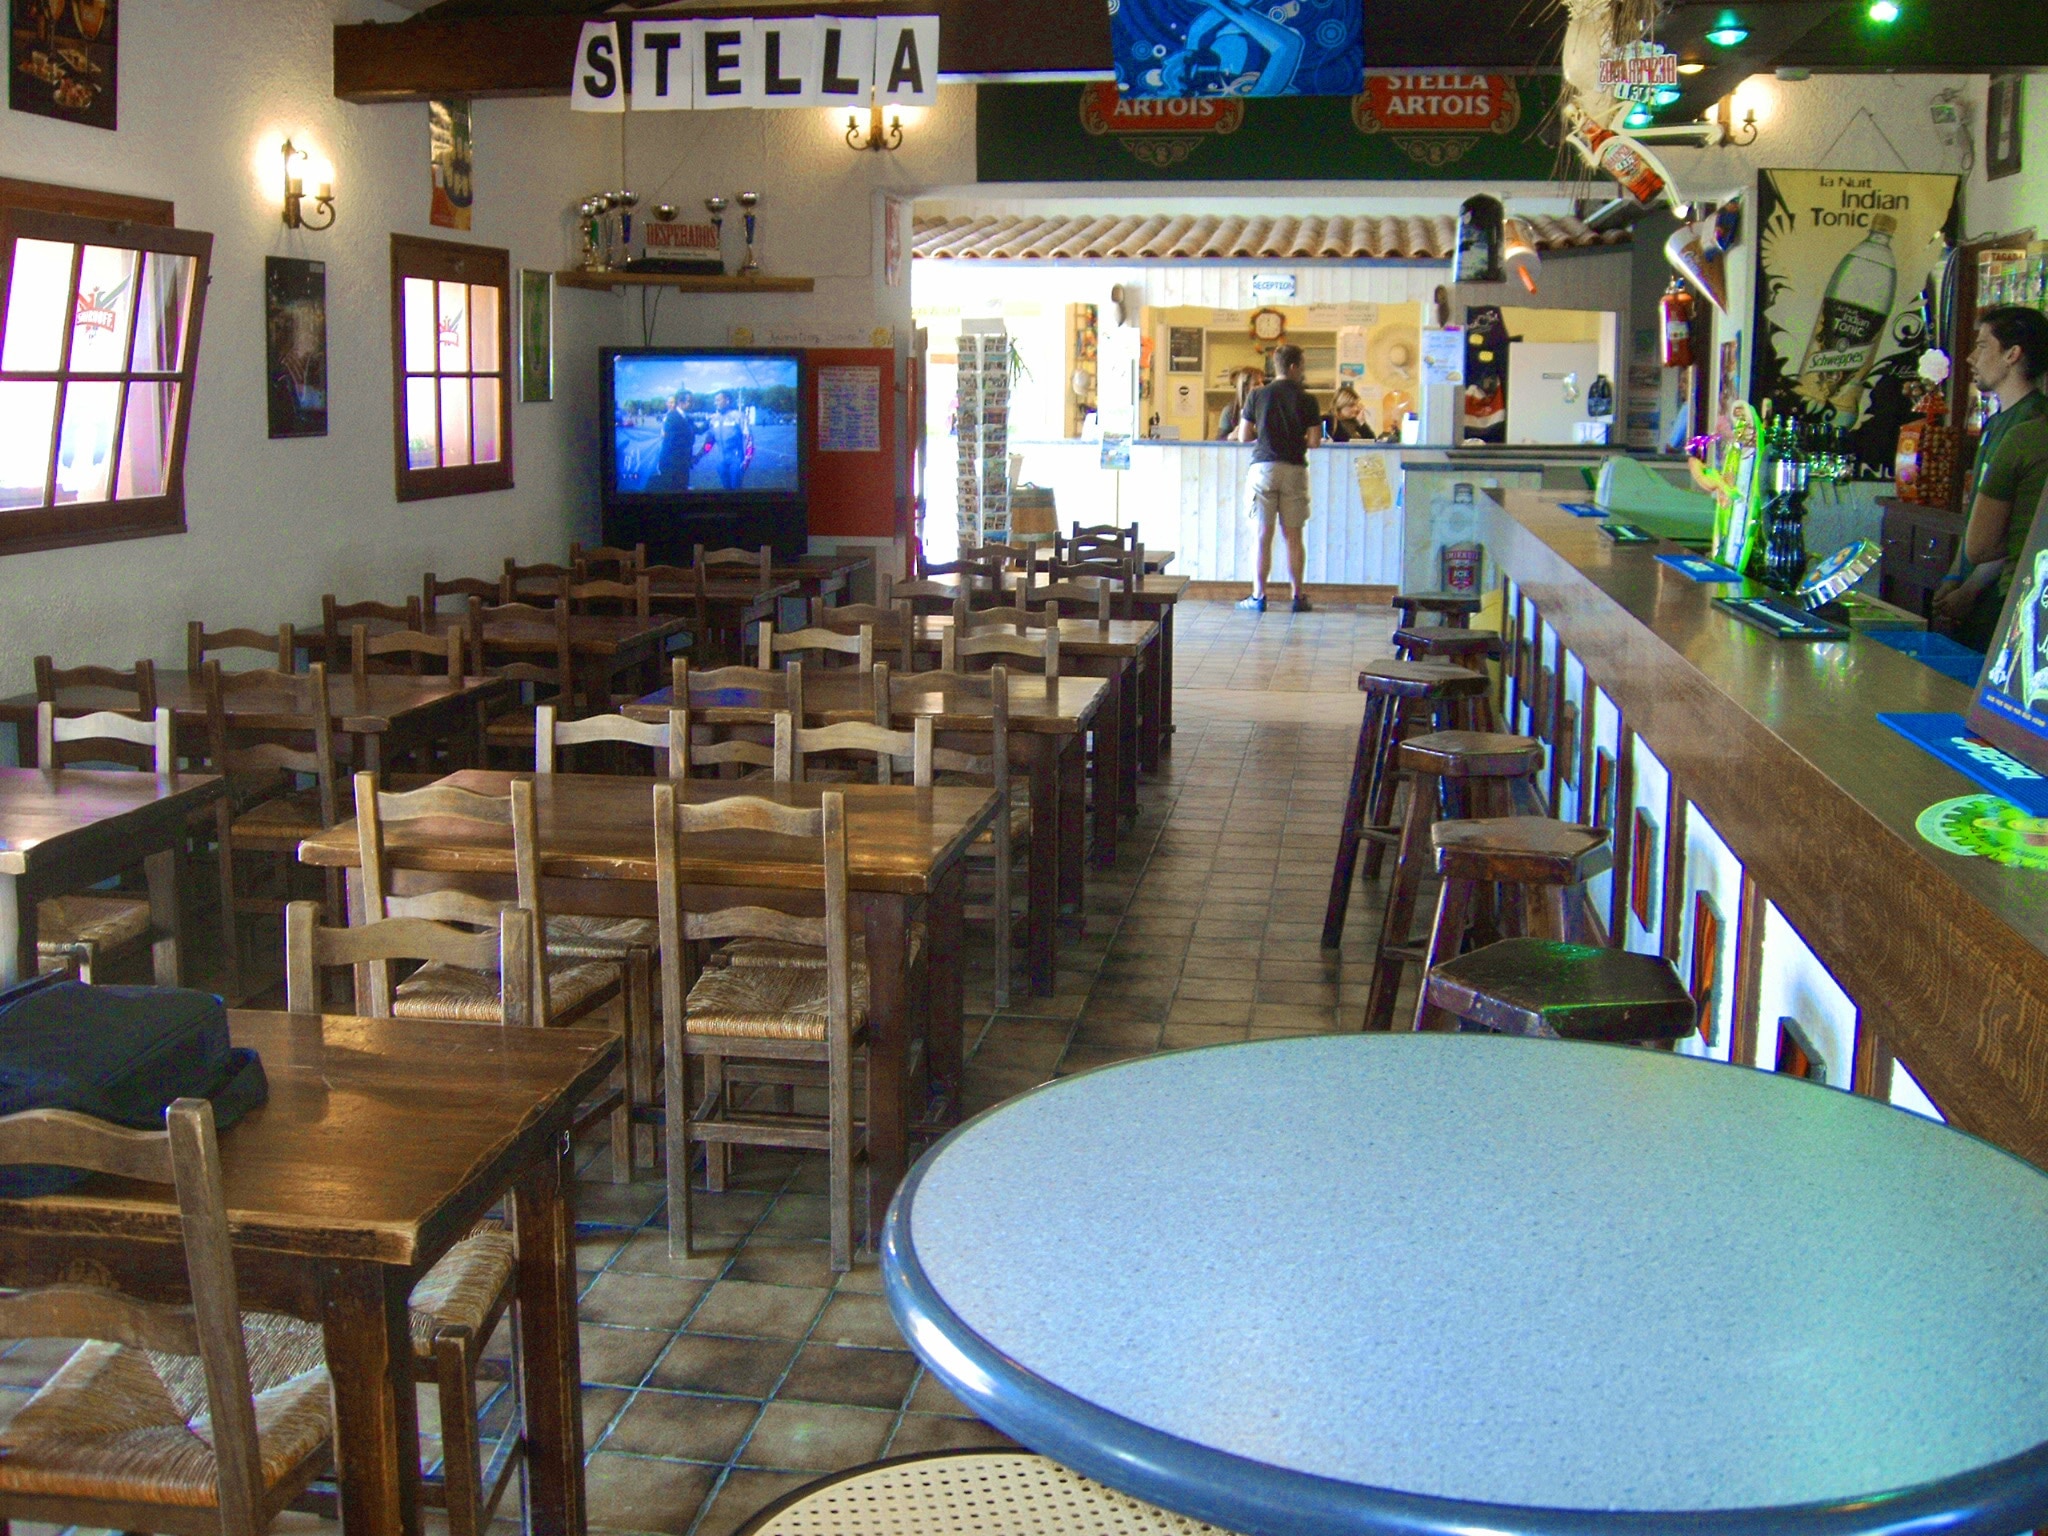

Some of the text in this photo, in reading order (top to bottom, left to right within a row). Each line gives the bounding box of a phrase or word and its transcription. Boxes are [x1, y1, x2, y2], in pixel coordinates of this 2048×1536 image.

[583, 28, 923, 99] STELLA
[1388, 75, 1488, 90] STELLA
[1114, 99, 1215, 116] ARTOIS
[1387, 95, 1490, 115] ARTOIS
[1839, 177, 1872, 189] Nuit
[1841, 189, 1910, 210] Indian
[1811, 207, 1869, 227] Tonic
[1833, 317, 1865, 337] Tonic
